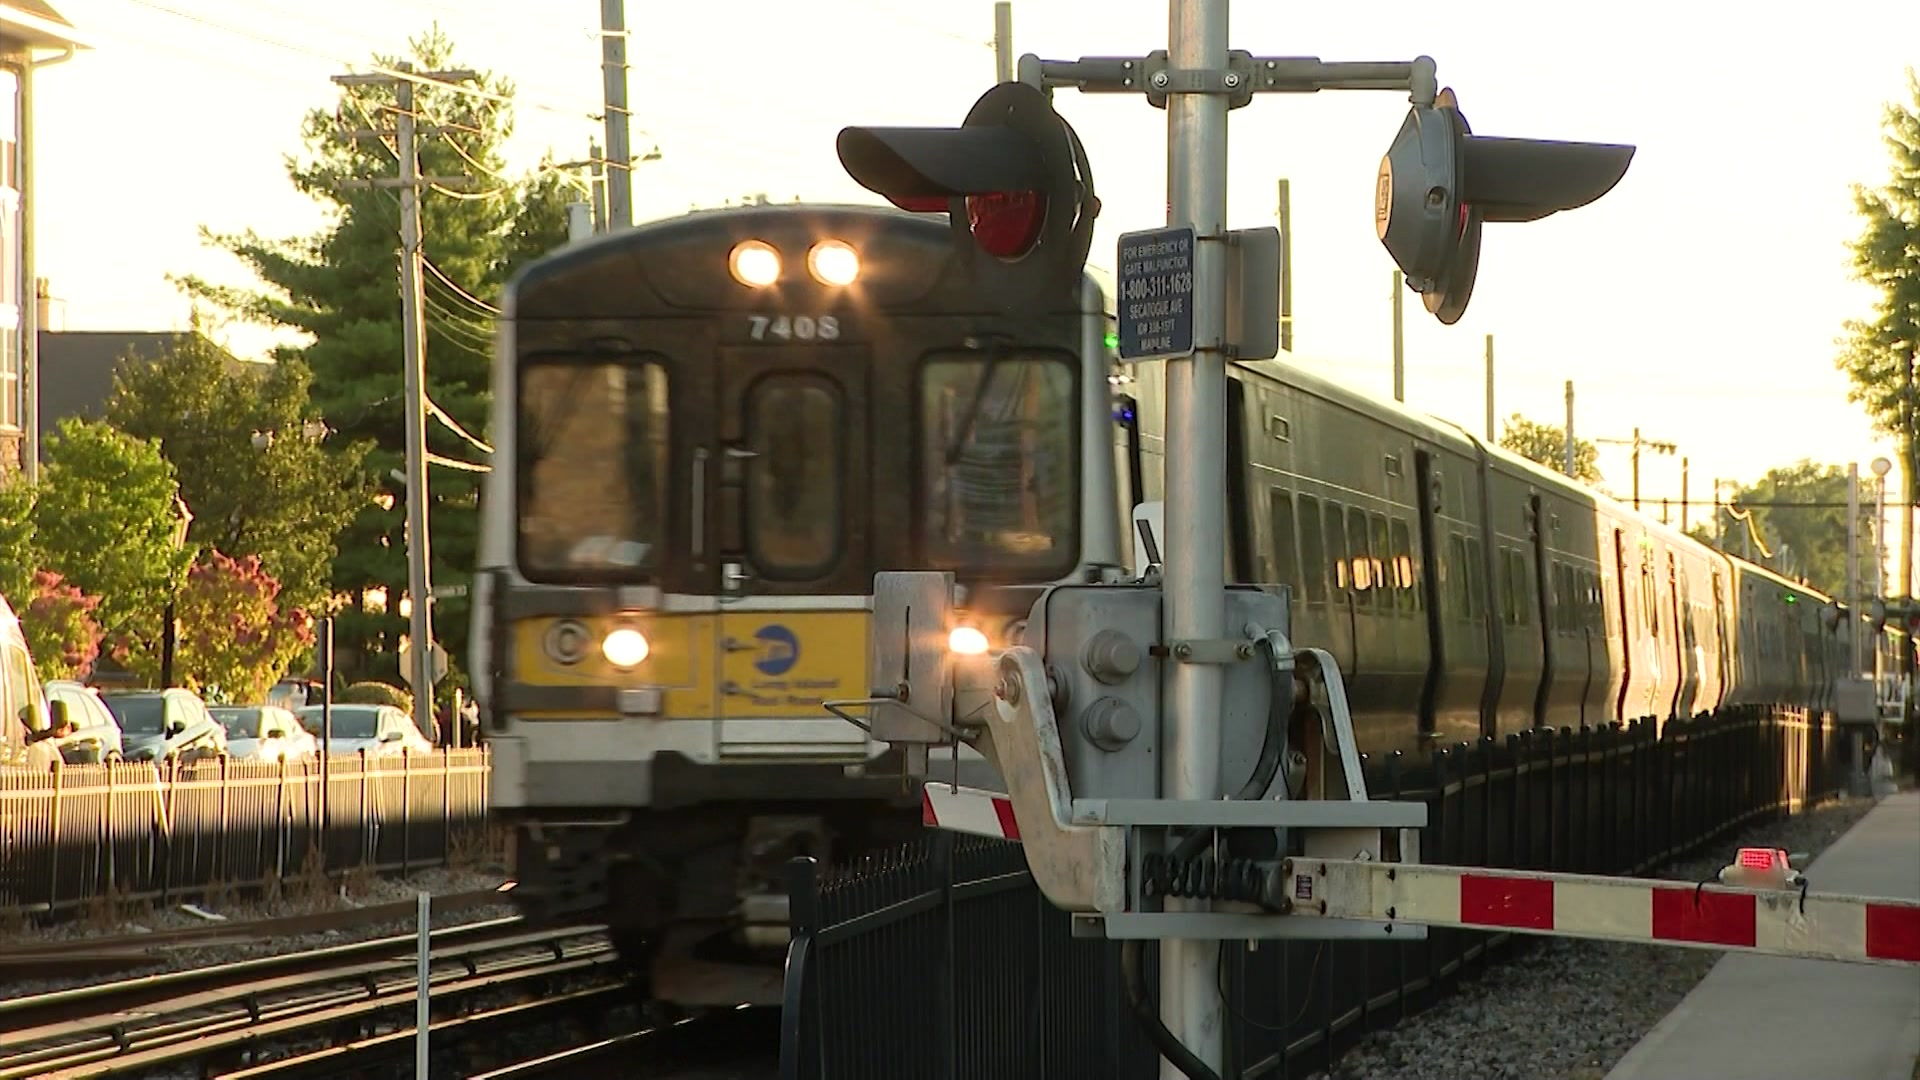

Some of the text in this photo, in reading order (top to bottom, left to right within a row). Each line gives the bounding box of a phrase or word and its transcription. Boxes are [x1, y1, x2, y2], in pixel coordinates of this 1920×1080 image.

[1123, 238, 1189, 260] FOR EMERGENCY OR
[1124, 256, 1189, 276] GATE MALFUNCTION
[1121, 272, 1192, 301] 1-800-311-1628
[1129, 298, 1184, 319] SECATOGUE AVE
[747, 315, 840, 340] 7408
